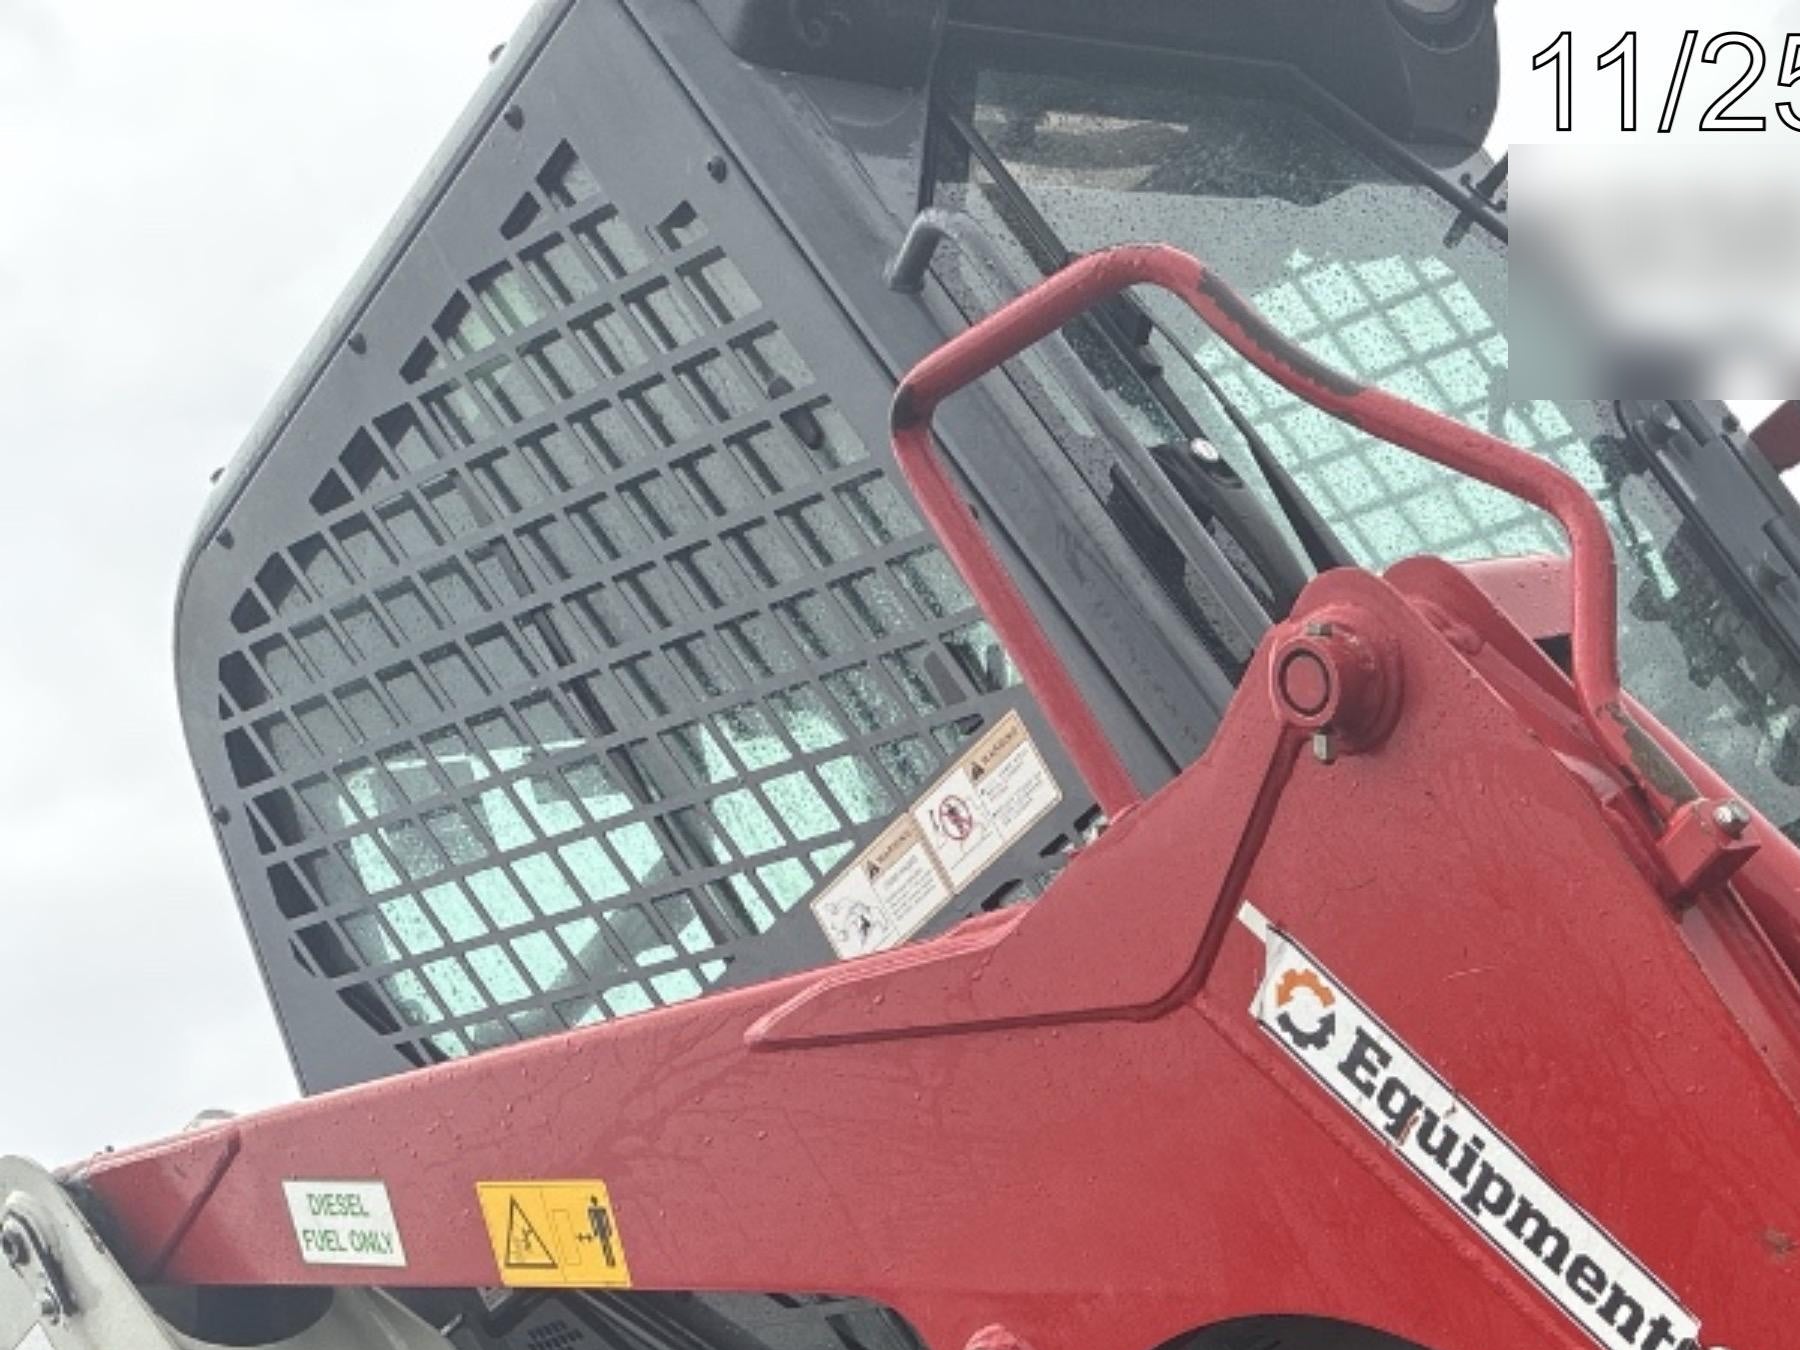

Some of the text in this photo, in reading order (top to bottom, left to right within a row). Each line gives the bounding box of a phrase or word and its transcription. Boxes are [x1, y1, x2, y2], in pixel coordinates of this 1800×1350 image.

[305, 1193, 370, 1217] DIESEL
[302, 1229, 394, 1255] FUEL ONLY
